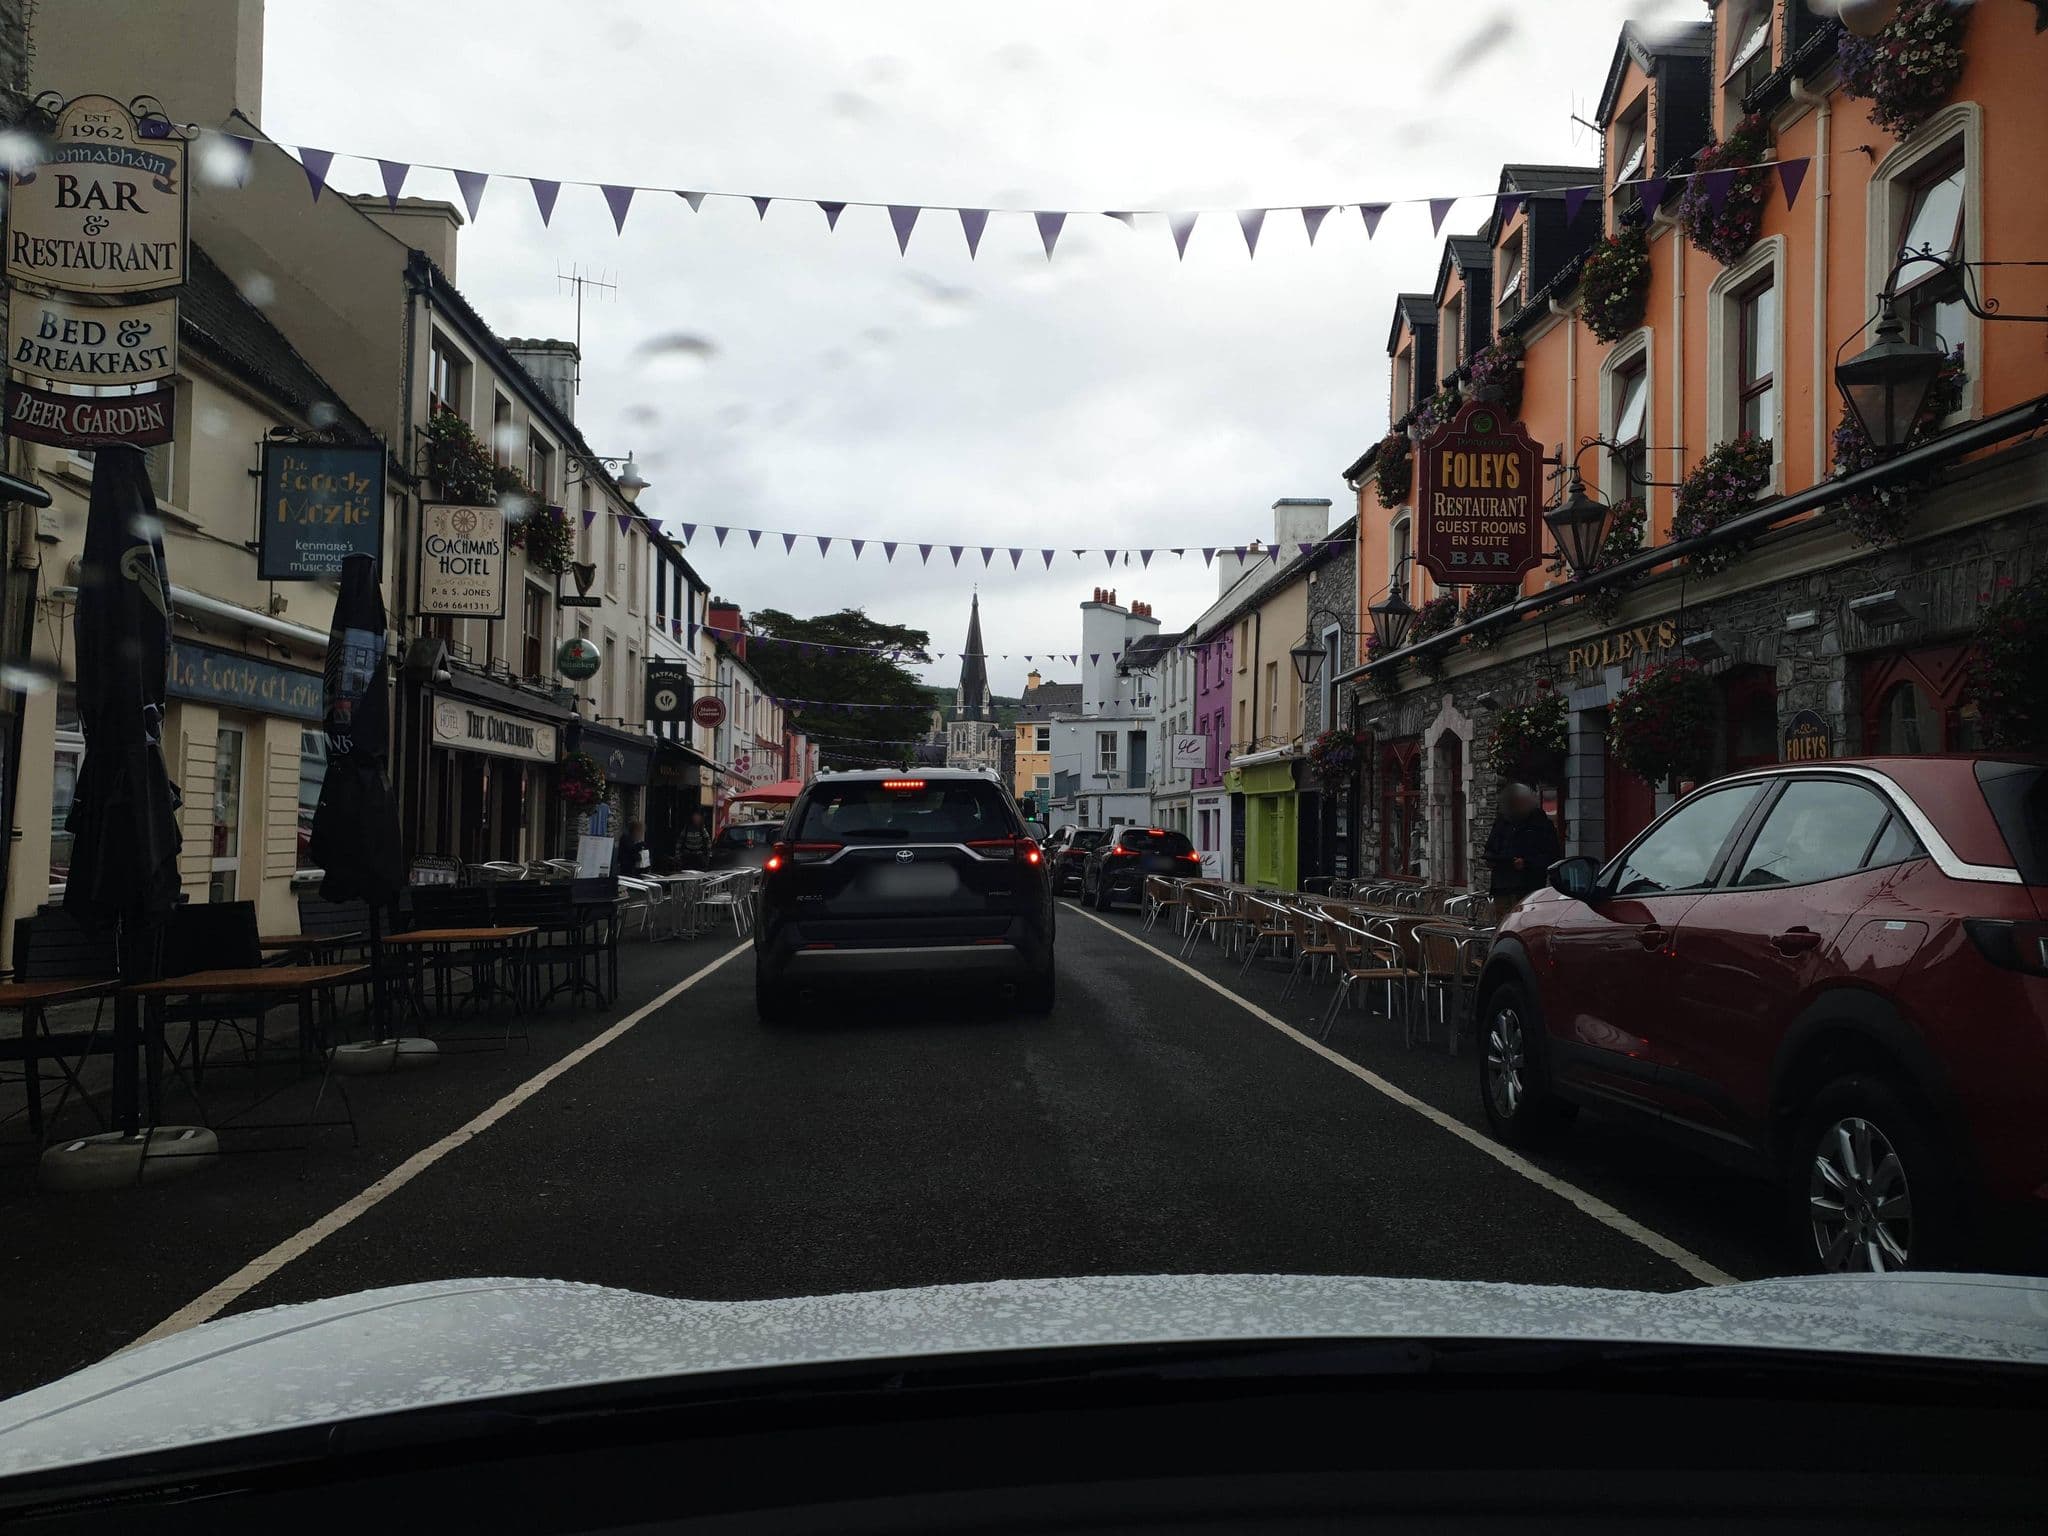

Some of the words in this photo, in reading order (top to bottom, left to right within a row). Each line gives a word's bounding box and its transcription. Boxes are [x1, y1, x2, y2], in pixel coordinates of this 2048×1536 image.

[84, 114, 111, 123] EST
[72, 125, 125, 140] 1962
[54, 174, 149, 214] BAR
[83, 215, 109, 236] &
[12, 230, 178, 273] RESTAURANT
[37, 310, 107, 345] BED
[117, 319, 152, 348] &
[14, 337, 169, 374] BREAKFAST
[12, 392, 73, 435] BEER
[72, 403, 166, 435] GARDEN
[1442, 450, 1520, 489] FOLEYS
[1433, 492, 1528, 518] RESTAURANT
[1435, 521, 1477, 533] GUEST
[1481, 522, 1527, 535] ROOMS
[1452, 536, 1468, 545] EN
[1472, 536, 1510, 546] SUITE
[325, 562, 342, 572] sto
[439, 556, 490, 575] HOTEL
[1451, 551, 1510, 565] BAR
[463, 587, 491, 597] JONES
[433, 601, 449, 609] 064
[1568, 617, 1679, 675] FOLEYS
[466, 710, 485, 739] THE
[1787, 735, 1826, 761] FOLEYS
